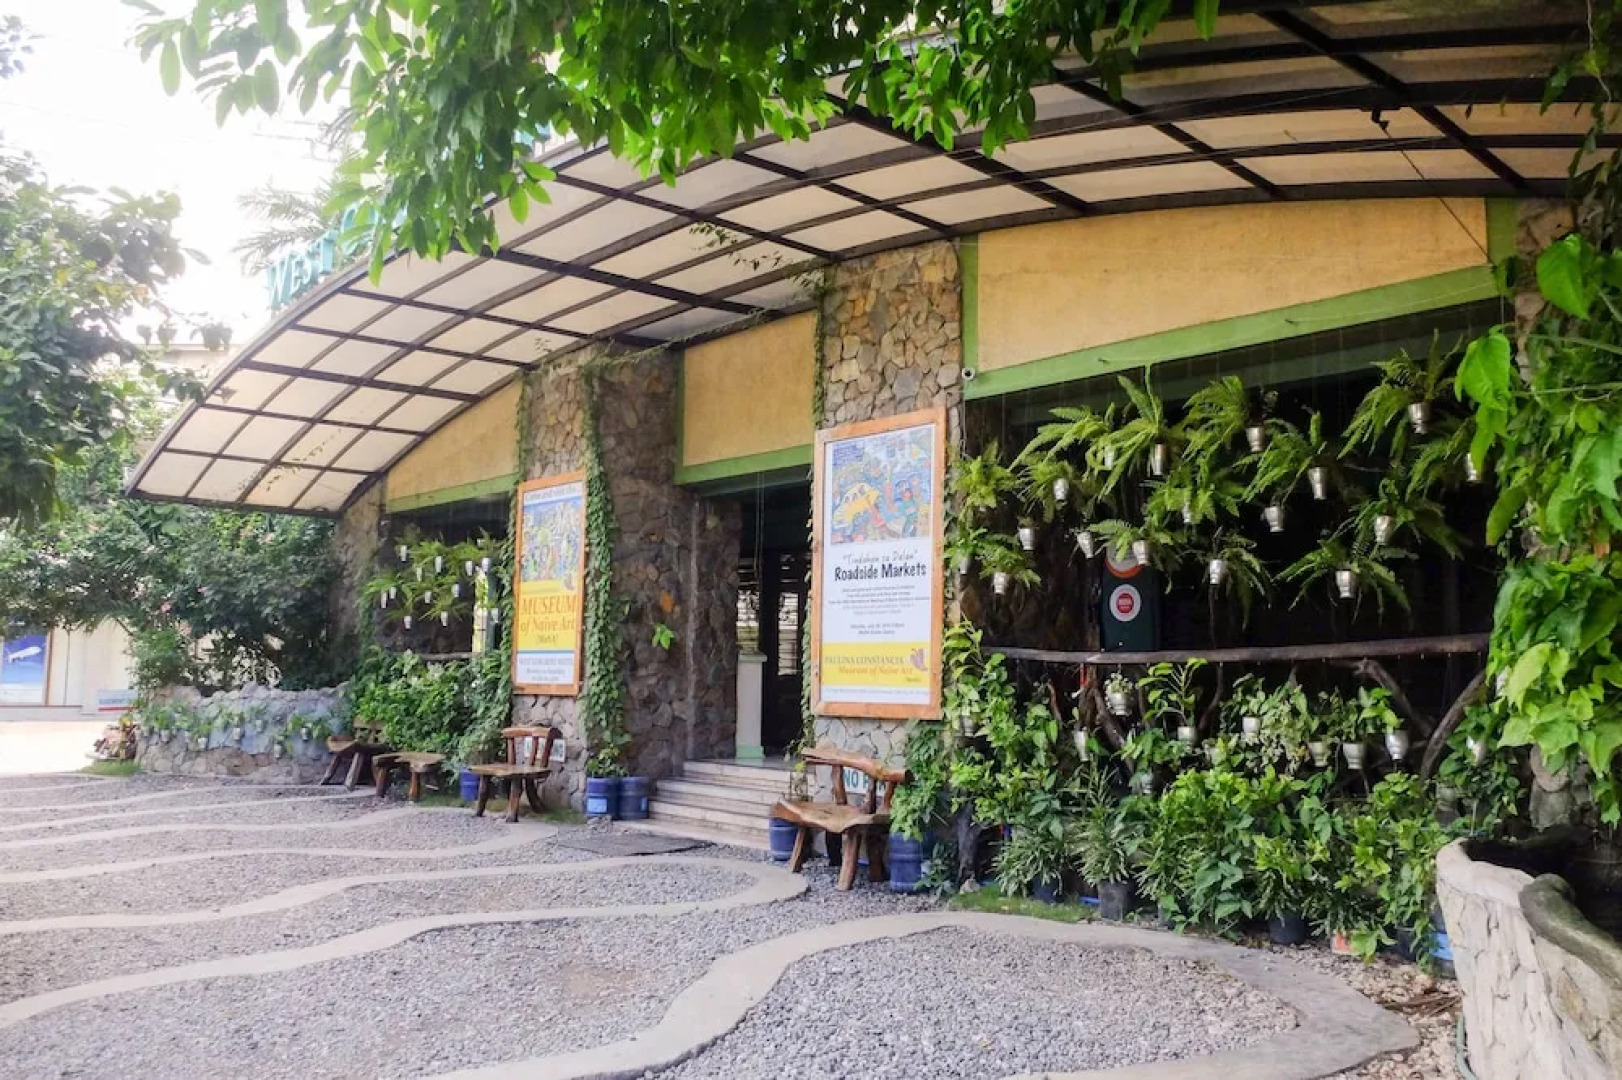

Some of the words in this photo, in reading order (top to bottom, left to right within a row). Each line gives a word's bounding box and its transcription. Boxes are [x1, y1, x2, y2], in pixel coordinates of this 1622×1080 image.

[267, 229, 340, 310] WEST
[834, 564, 879, 581] Roadside
[881, 562, 927, 578] Markets
[520, 594, 577, 615] MUSEUM
[844, 769, 859, 788] NO
